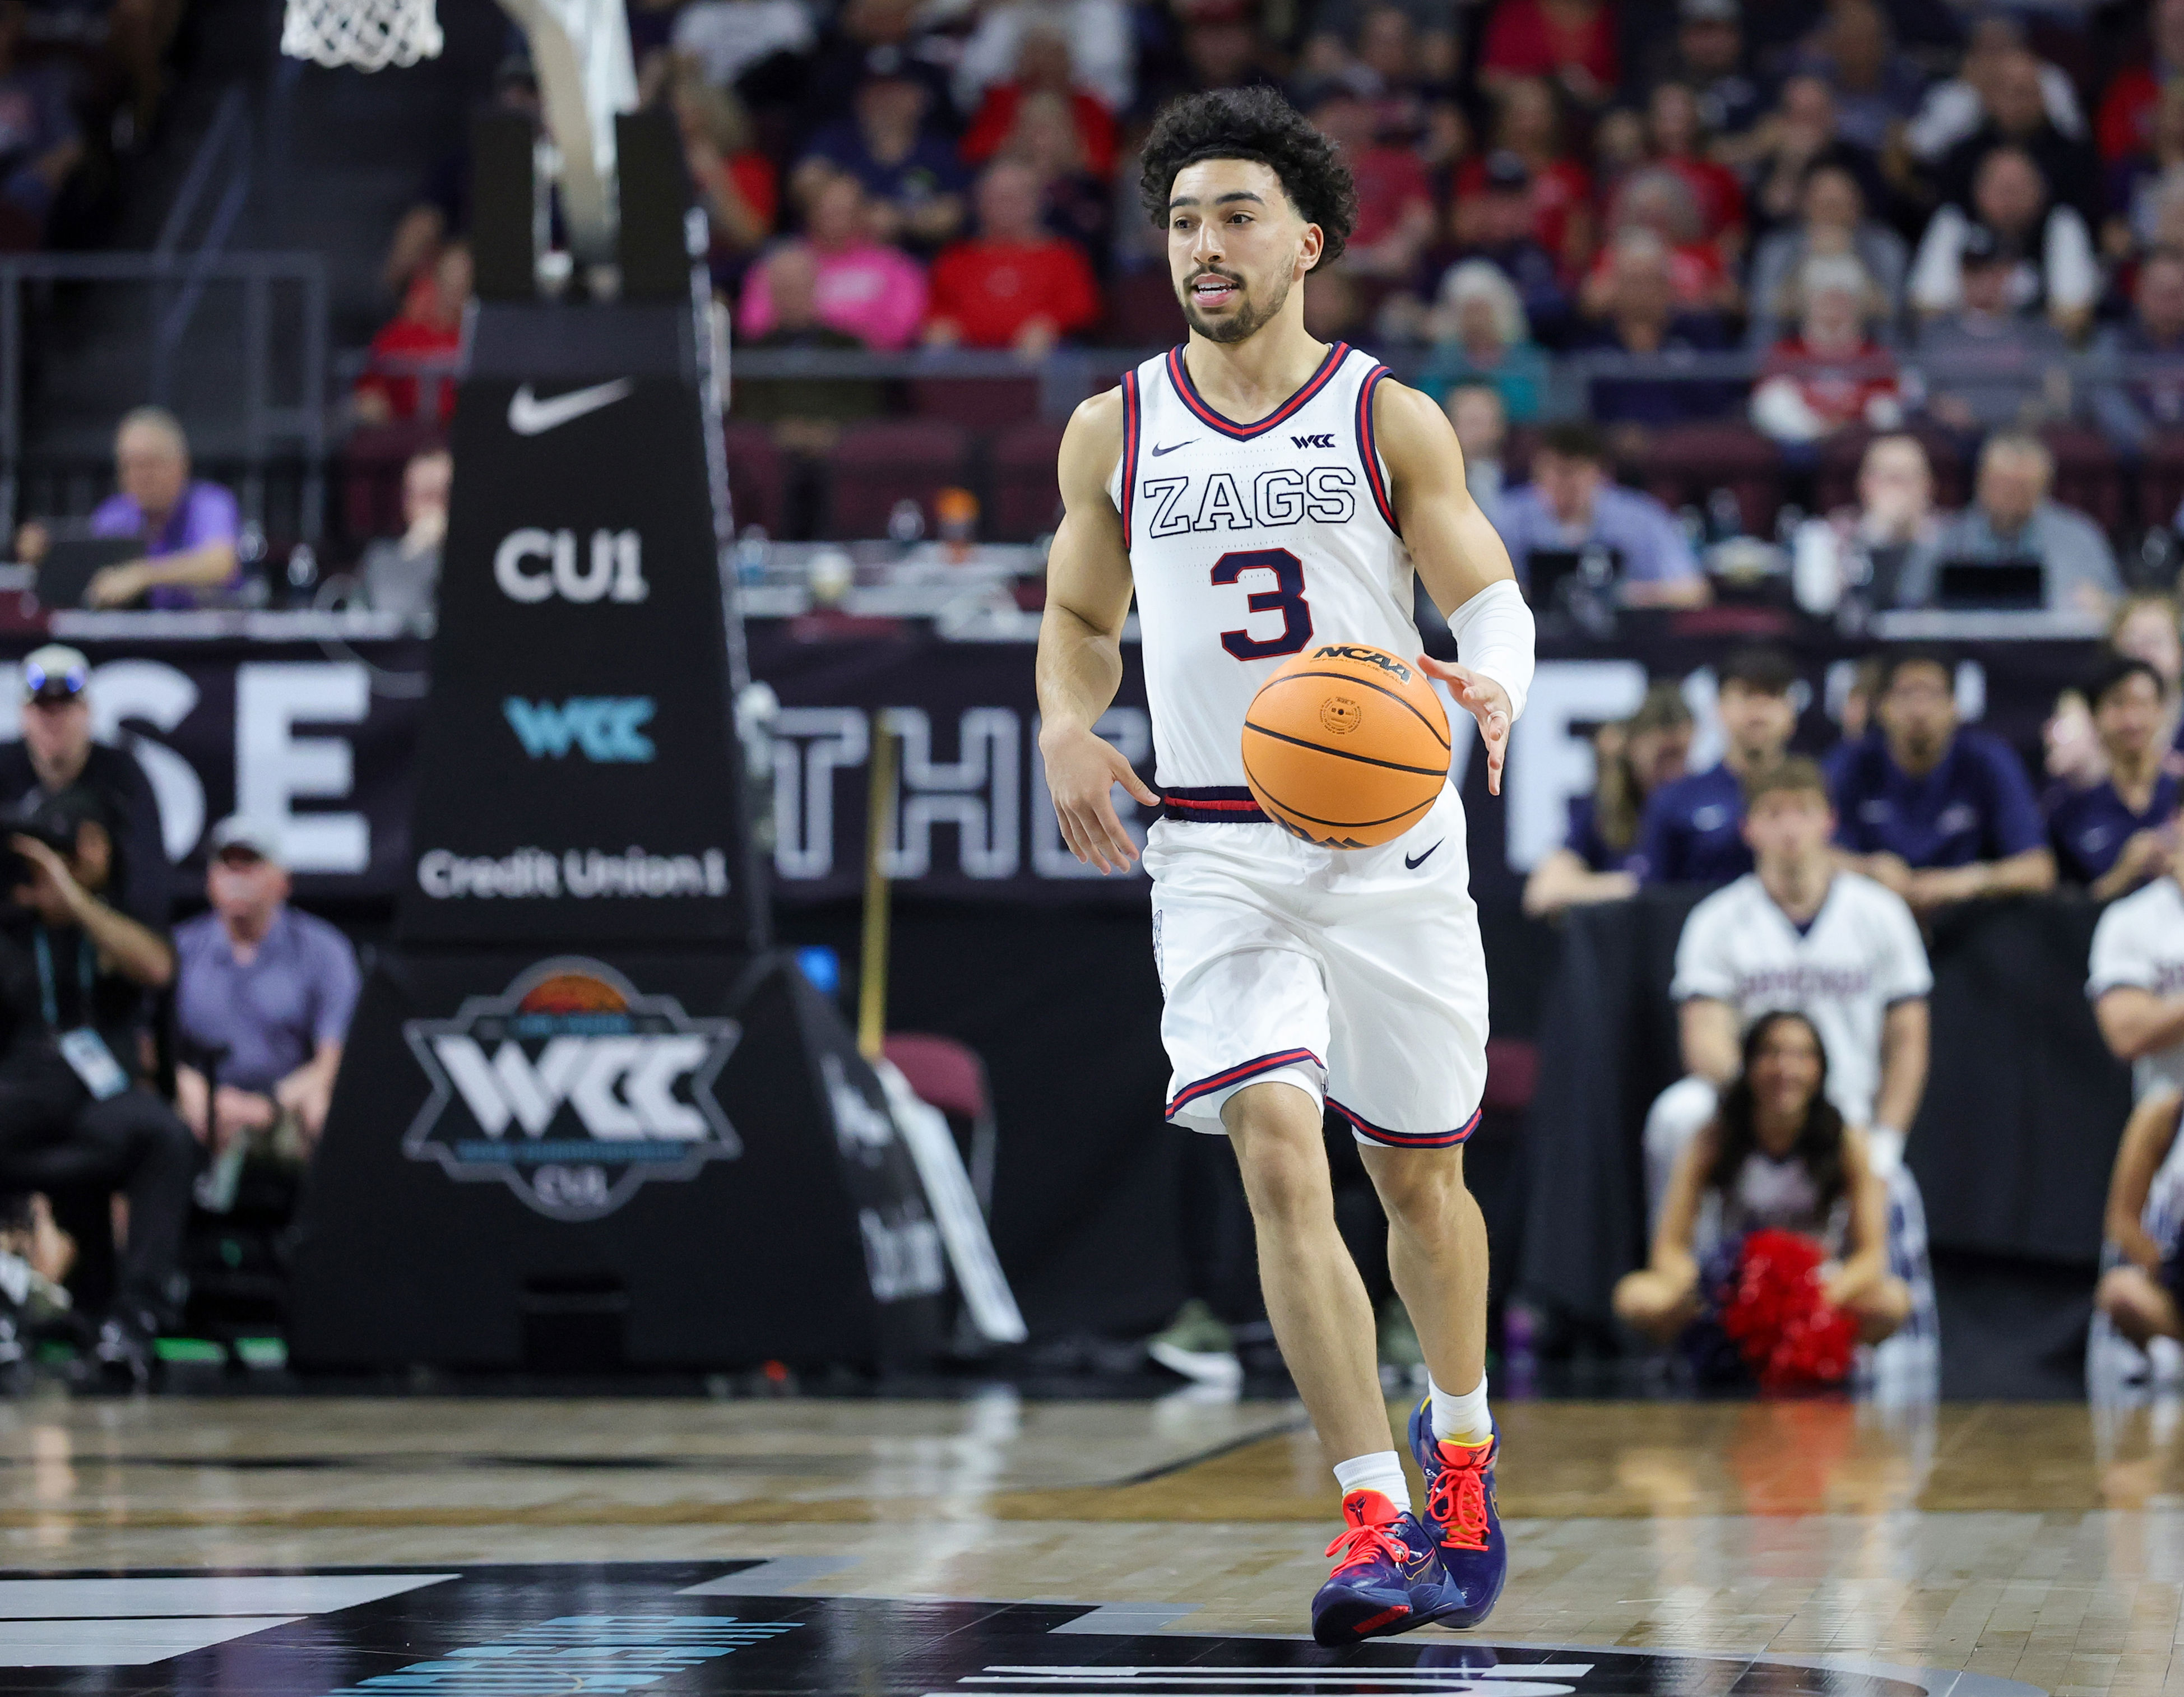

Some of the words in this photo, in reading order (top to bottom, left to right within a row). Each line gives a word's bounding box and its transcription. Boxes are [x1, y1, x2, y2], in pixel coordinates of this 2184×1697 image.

[1290, 434, 1336, 449] WCC
[1143, 467, 1356, 539] ZAGS
[494, 527, 650, 603] CU1
[1211, 547, 1314, 661] 3
[1313, 646, 1412, 685] NCAA
[1353, 660, 1380, 672] GAME
[502, 695, 657, 763] WCC
[0, 657, 371, 875] SE
[417, 846, 562, 899] Credit
[433, 1034, 710, 1142] WCC
